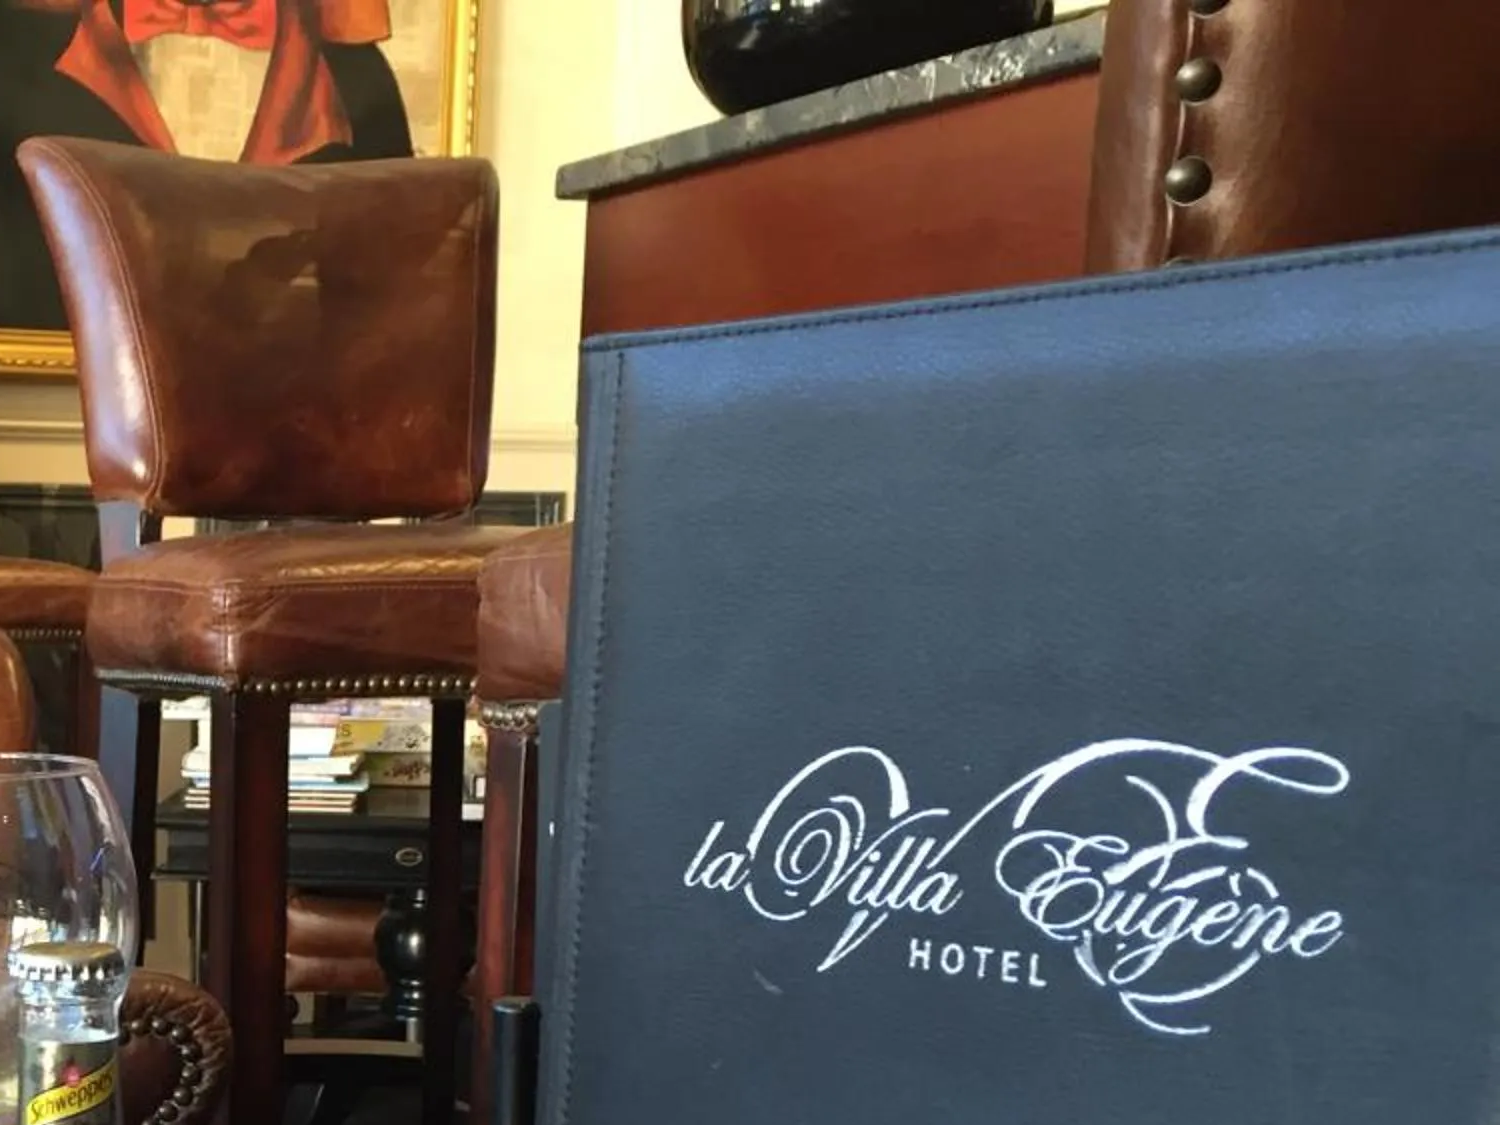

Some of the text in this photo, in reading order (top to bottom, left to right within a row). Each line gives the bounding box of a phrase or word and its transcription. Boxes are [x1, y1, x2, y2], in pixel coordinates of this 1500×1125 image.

[684, 821, 750, 892] la
[908, 937, 1047, 988] HOTEL
[31, 1073, 113, 1124] Schweppes
